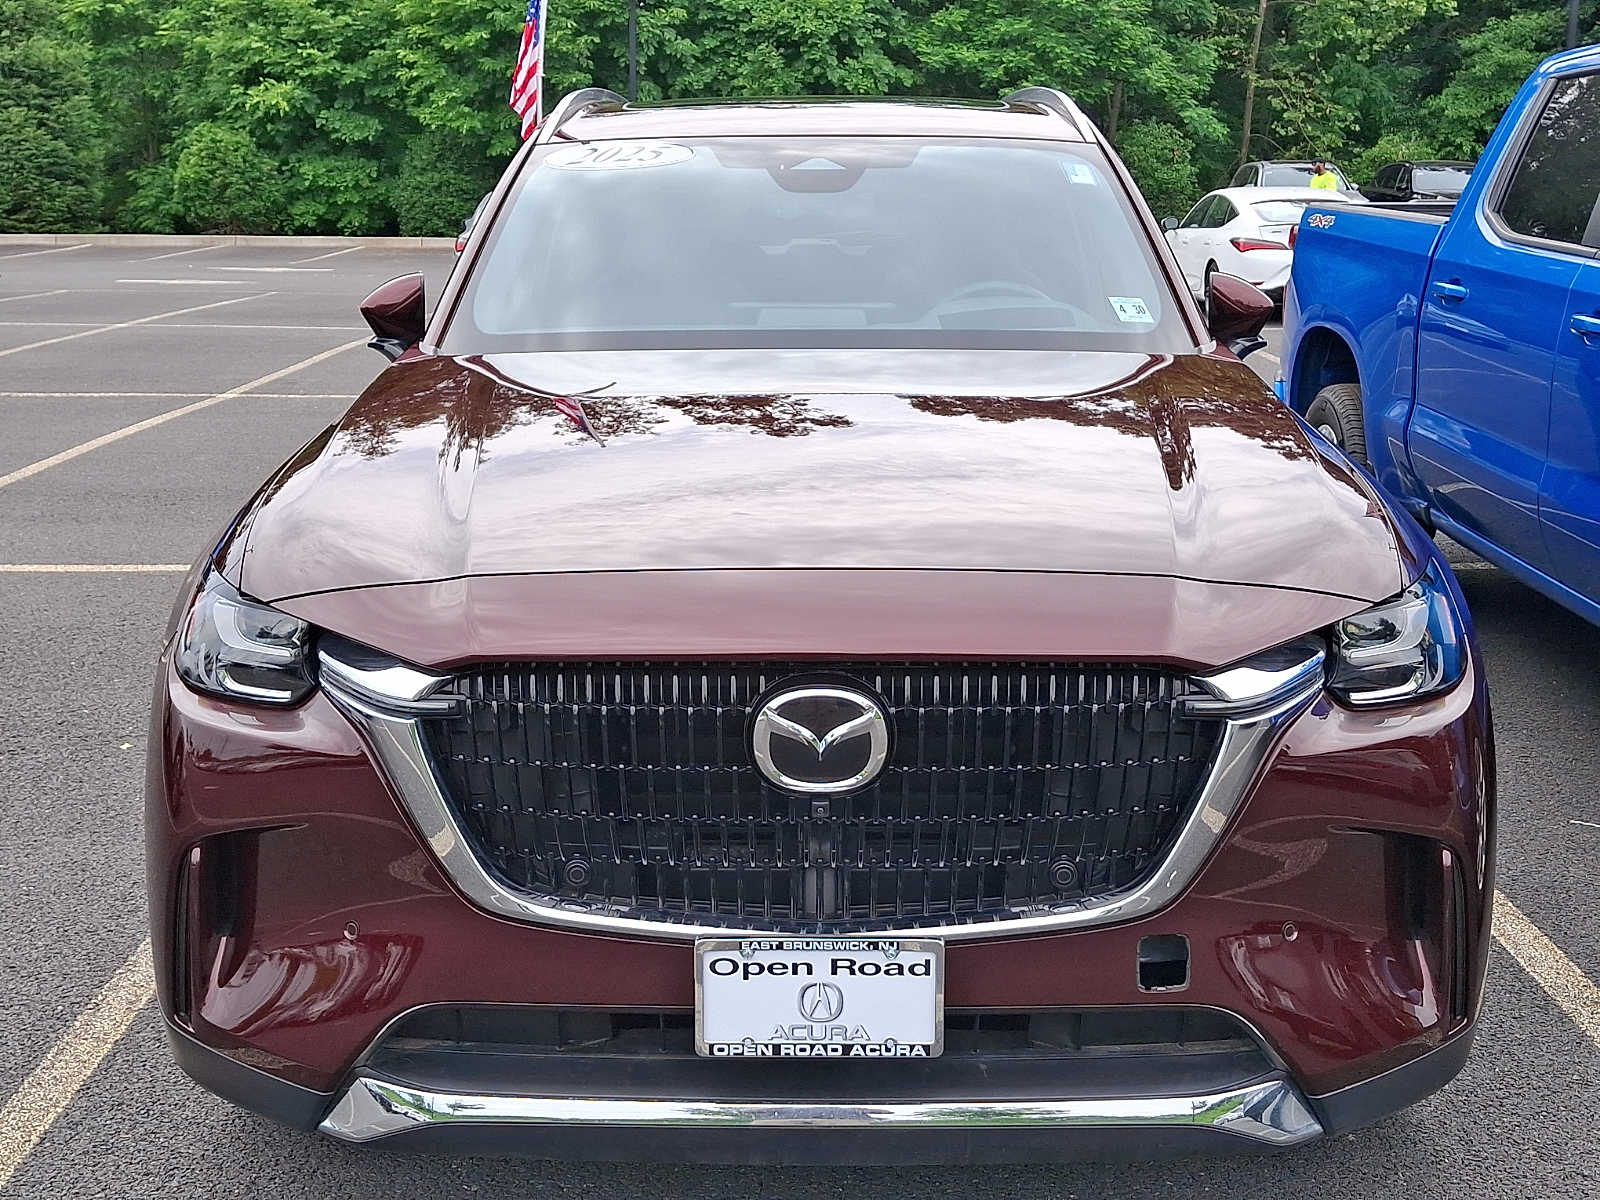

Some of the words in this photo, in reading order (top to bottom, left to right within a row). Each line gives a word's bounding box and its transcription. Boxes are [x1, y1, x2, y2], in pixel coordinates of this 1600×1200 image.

[565, 146, 673, 166] 2025
[1119, 304, 1127, 314] 4
[741, 941, 778, 950] EAST
[879, 941, 898, 951] NJ
[709, 957, 814, 981] Open
[830, 958, 931, 976] Road
[768, 1024, 871, 1041] ACURA
[713, 1044, 773, 1056] OPEN
[780, 1044, 843, 1056] ROAD
[849, 1044, 927, 1057] ACURA
